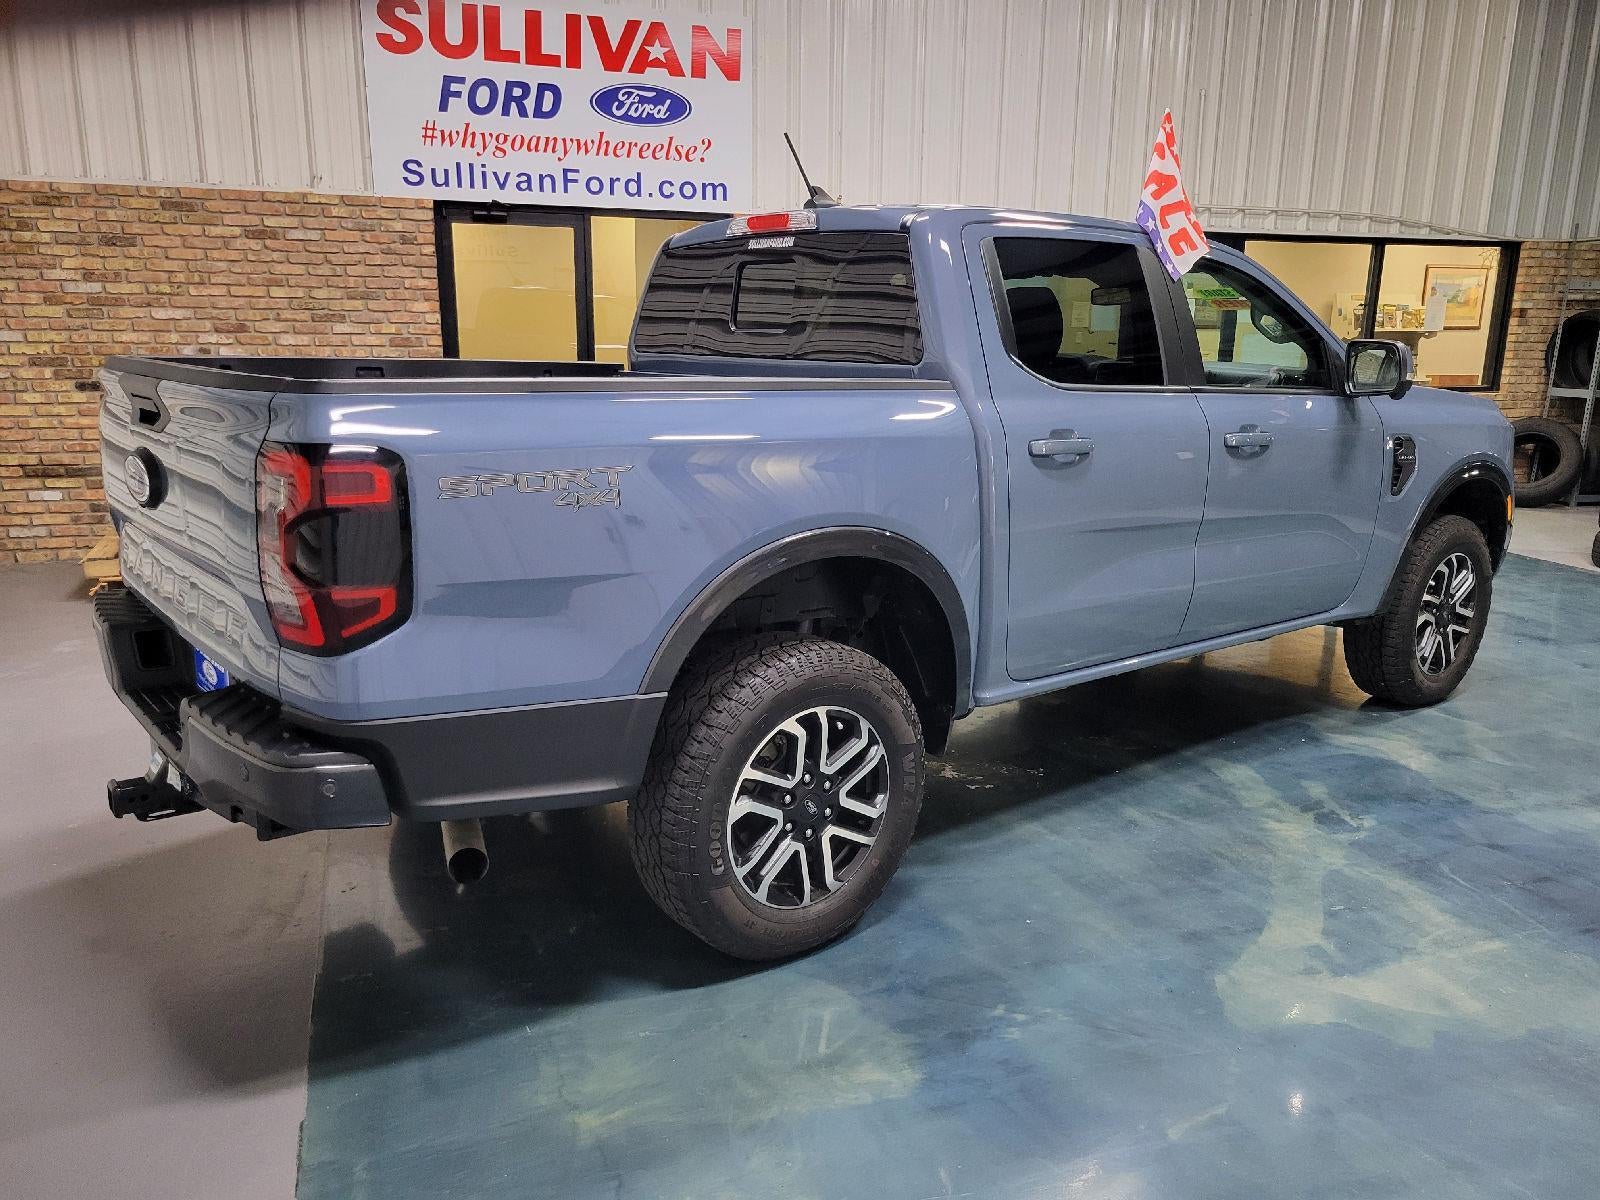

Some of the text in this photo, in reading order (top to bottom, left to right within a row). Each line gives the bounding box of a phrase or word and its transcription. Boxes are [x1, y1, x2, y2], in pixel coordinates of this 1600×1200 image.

[375, 0, 742, 82] SULLIVAN
[438, 74, 671, 120] FORD Ford
[421, 119, 713, 163] #whygoanywhereelse?
[402, 158, 728, 202] SullivanFord.com
[437, 464, 635, 500] SPORT
